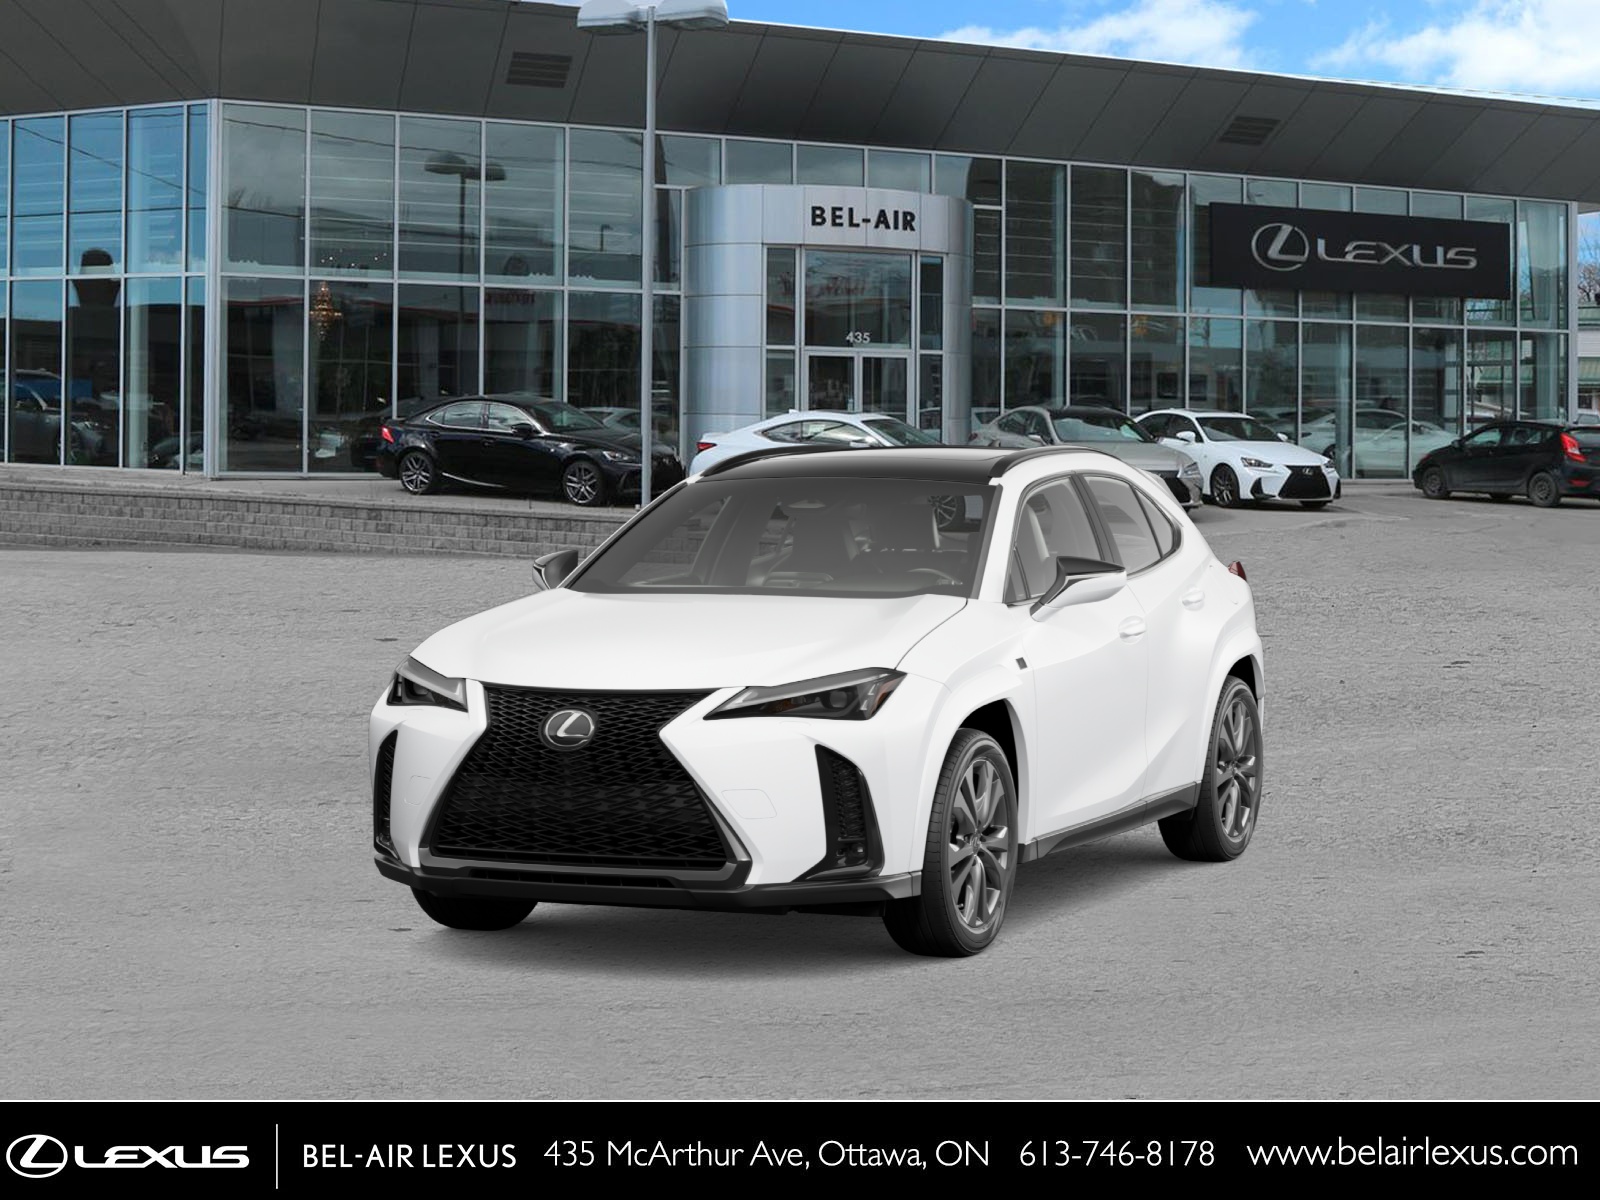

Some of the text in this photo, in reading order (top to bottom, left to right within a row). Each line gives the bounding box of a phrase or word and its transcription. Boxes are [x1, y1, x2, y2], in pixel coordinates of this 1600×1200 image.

[811, 205, 917, 232] BEL-AIR
[1317, 237, 1478, 269] LEXUS
[845, 331, 872, 344] 435
